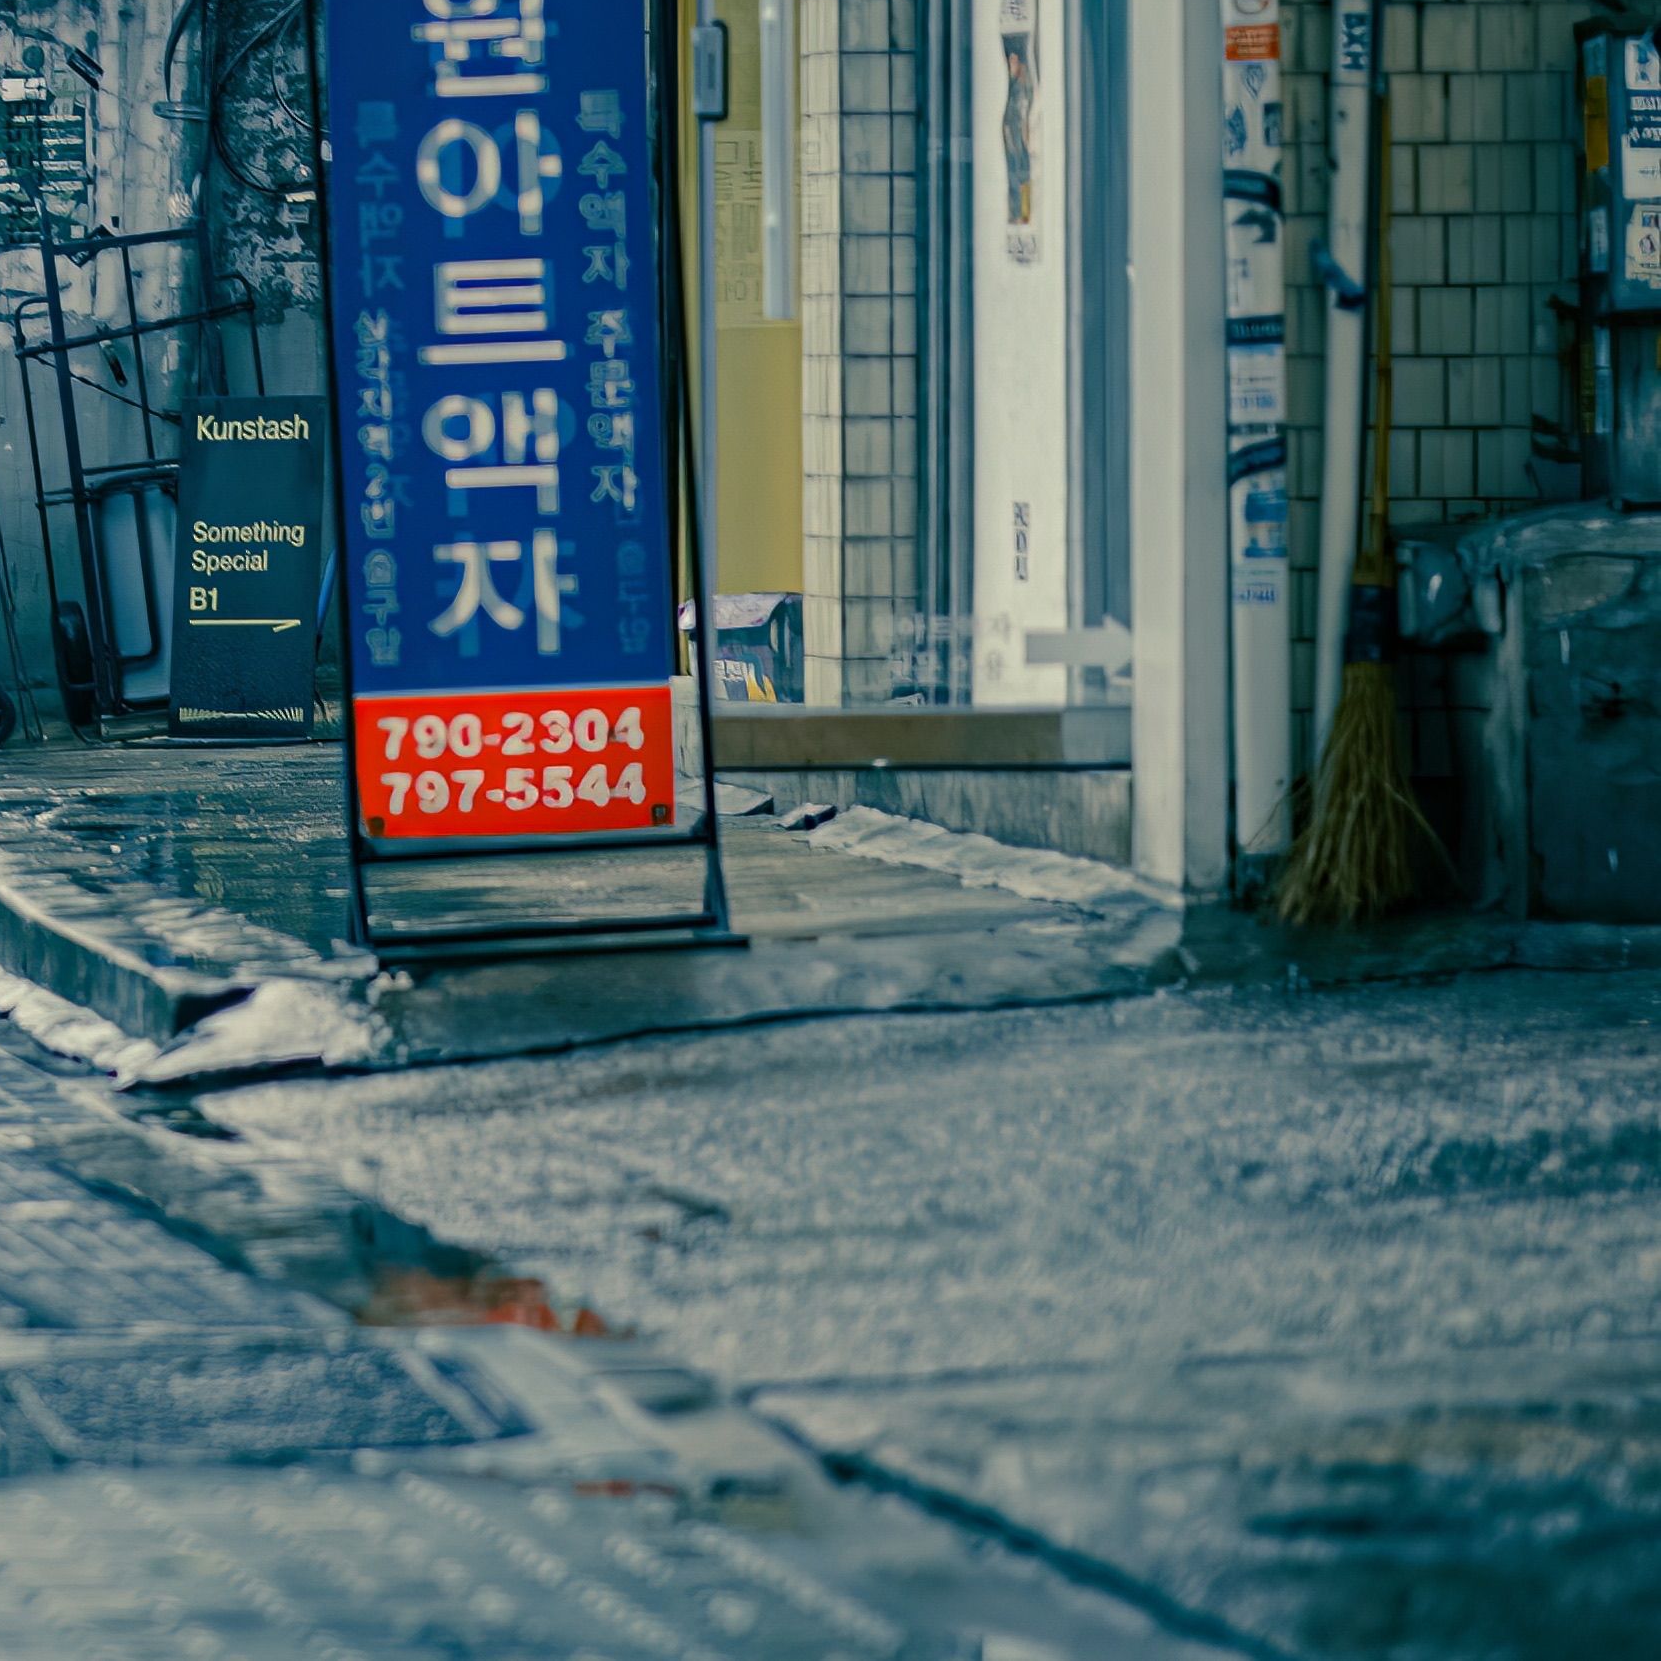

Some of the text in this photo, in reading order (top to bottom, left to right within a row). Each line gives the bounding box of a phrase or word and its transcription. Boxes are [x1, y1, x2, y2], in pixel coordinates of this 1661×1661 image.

[196, 414, 310, 441] Kunstash
[192, 520, 305, 547] Something
[191, 550, 268, 576] Special
[189, 586, 218, 611] B1
[378, 706, 645, 760] 790-2304
[380, 762, 647, 815] 797-5544
